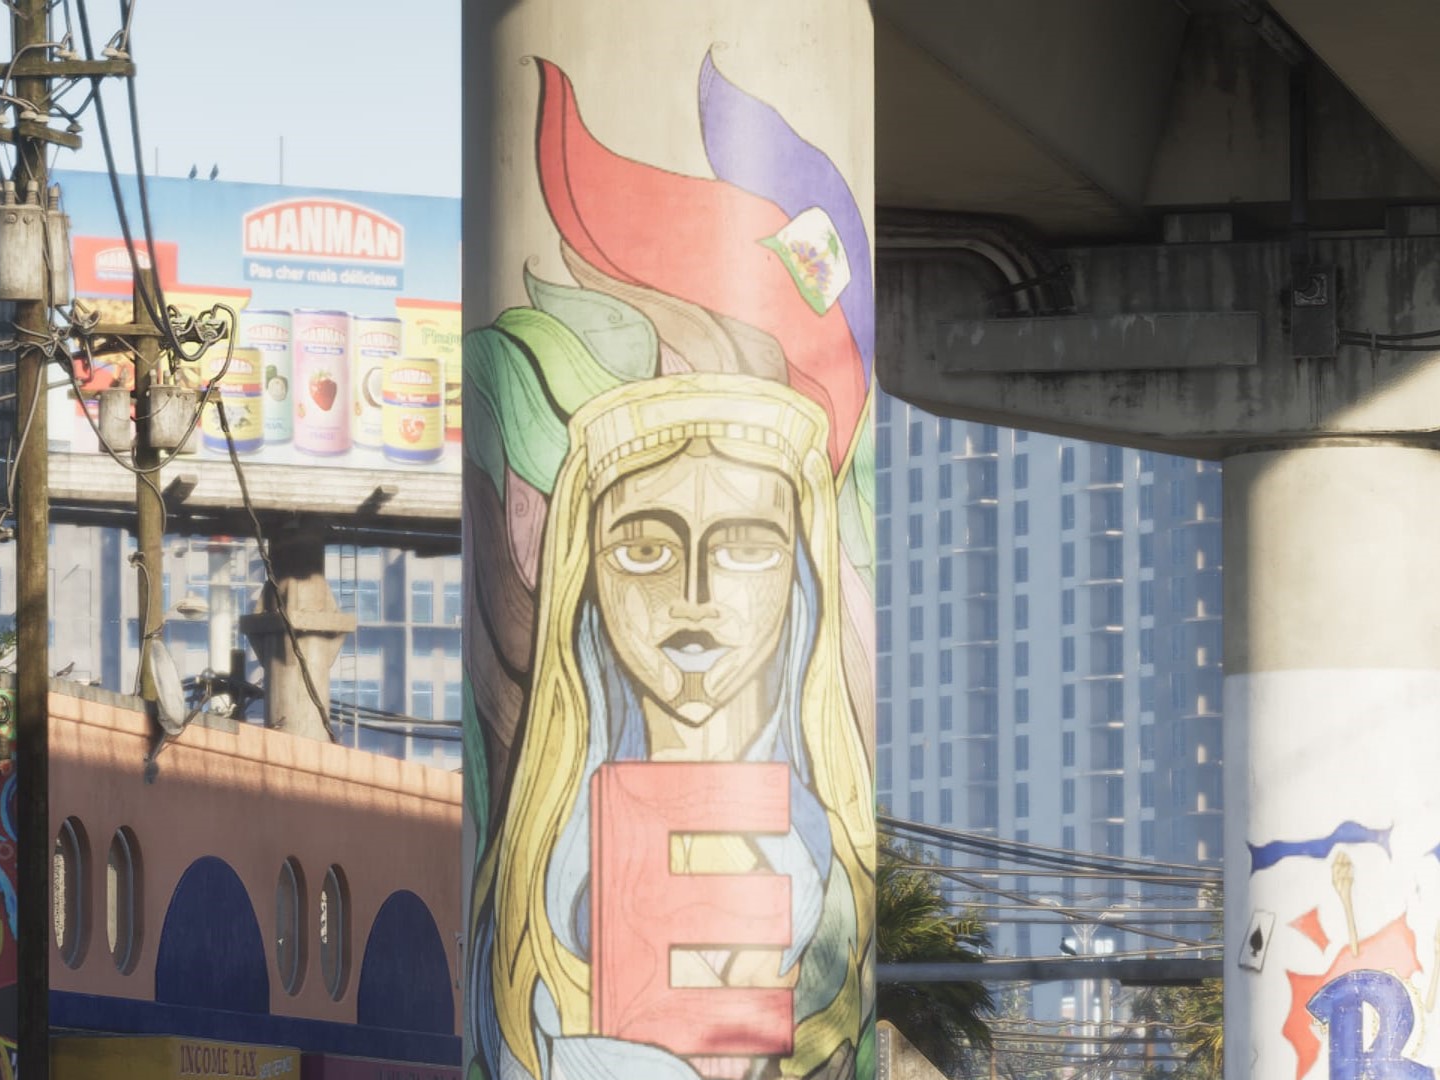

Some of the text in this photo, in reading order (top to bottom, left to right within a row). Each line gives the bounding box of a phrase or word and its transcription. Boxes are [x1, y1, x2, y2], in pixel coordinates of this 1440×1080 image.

[248, 206, 399, 257] MANMAN
[250, 263, 398, 288] Pas cher mais délicieux
[180, 1044, 229, 1075] INCOME
[234, 1048, 257, 1077] TAX
